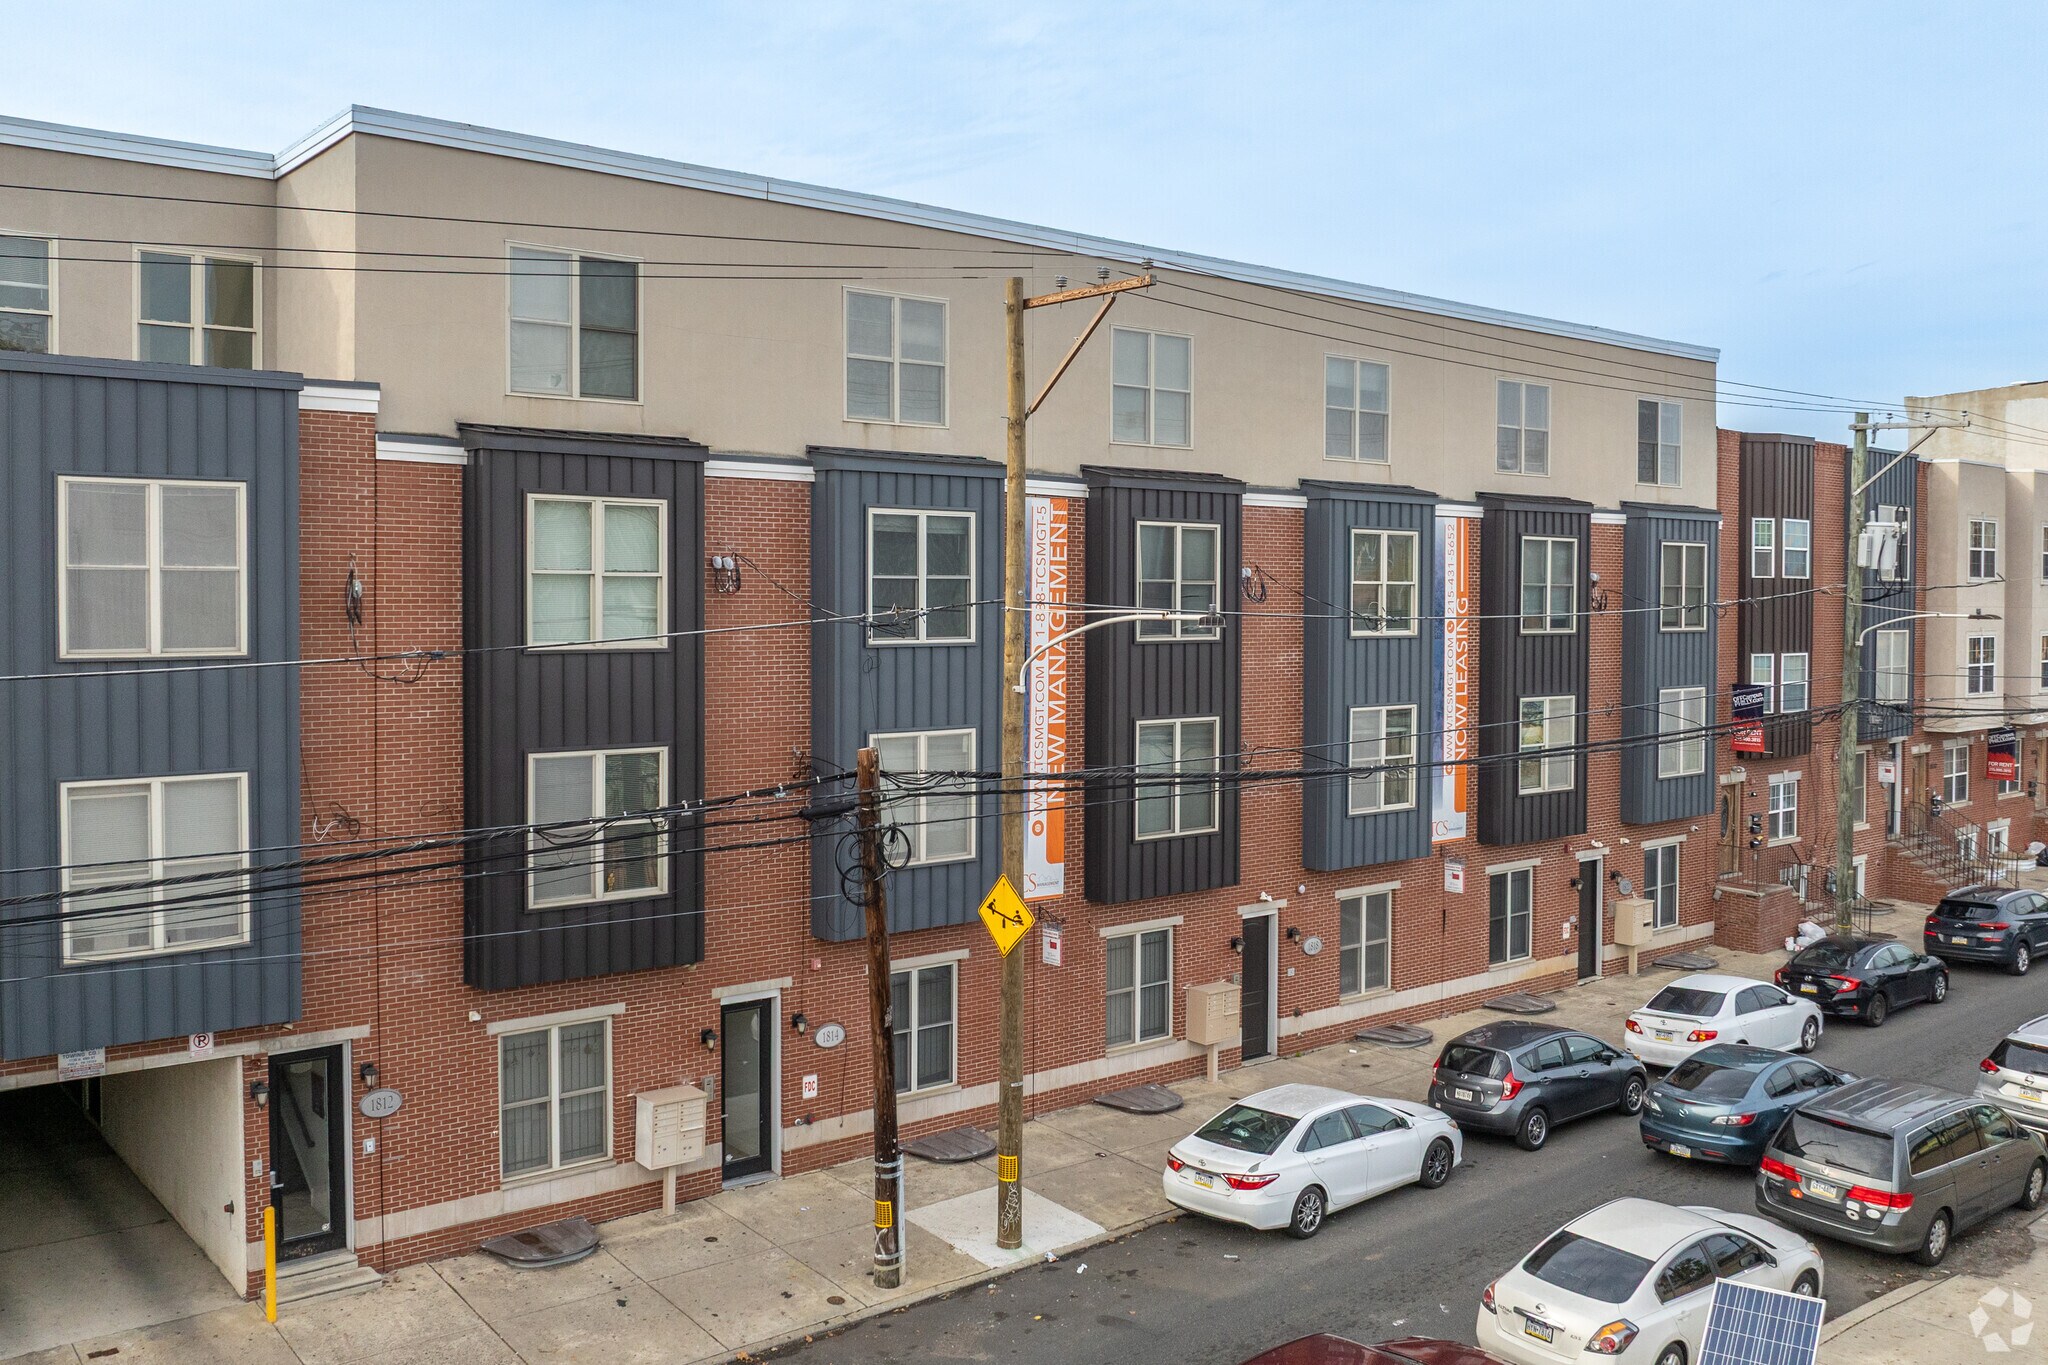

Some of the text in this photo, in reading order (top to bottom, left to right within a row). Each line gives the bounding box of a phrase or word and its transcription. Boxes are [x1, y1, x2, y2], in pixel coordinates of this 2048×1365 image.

[1447, 524, 1455, 614] 215-431-5652
[1047, 503, 1068, 803] NEW MANAGEMENT
[1455, 597, 1468, 764] NOW LEASING
[822, 1029, 839, 1043] 1814
[62, 1052, 85, 1060] TOWING
[804, 1080, 816, 1093] FDC
[371, 1095, 394, 1111] 1812
